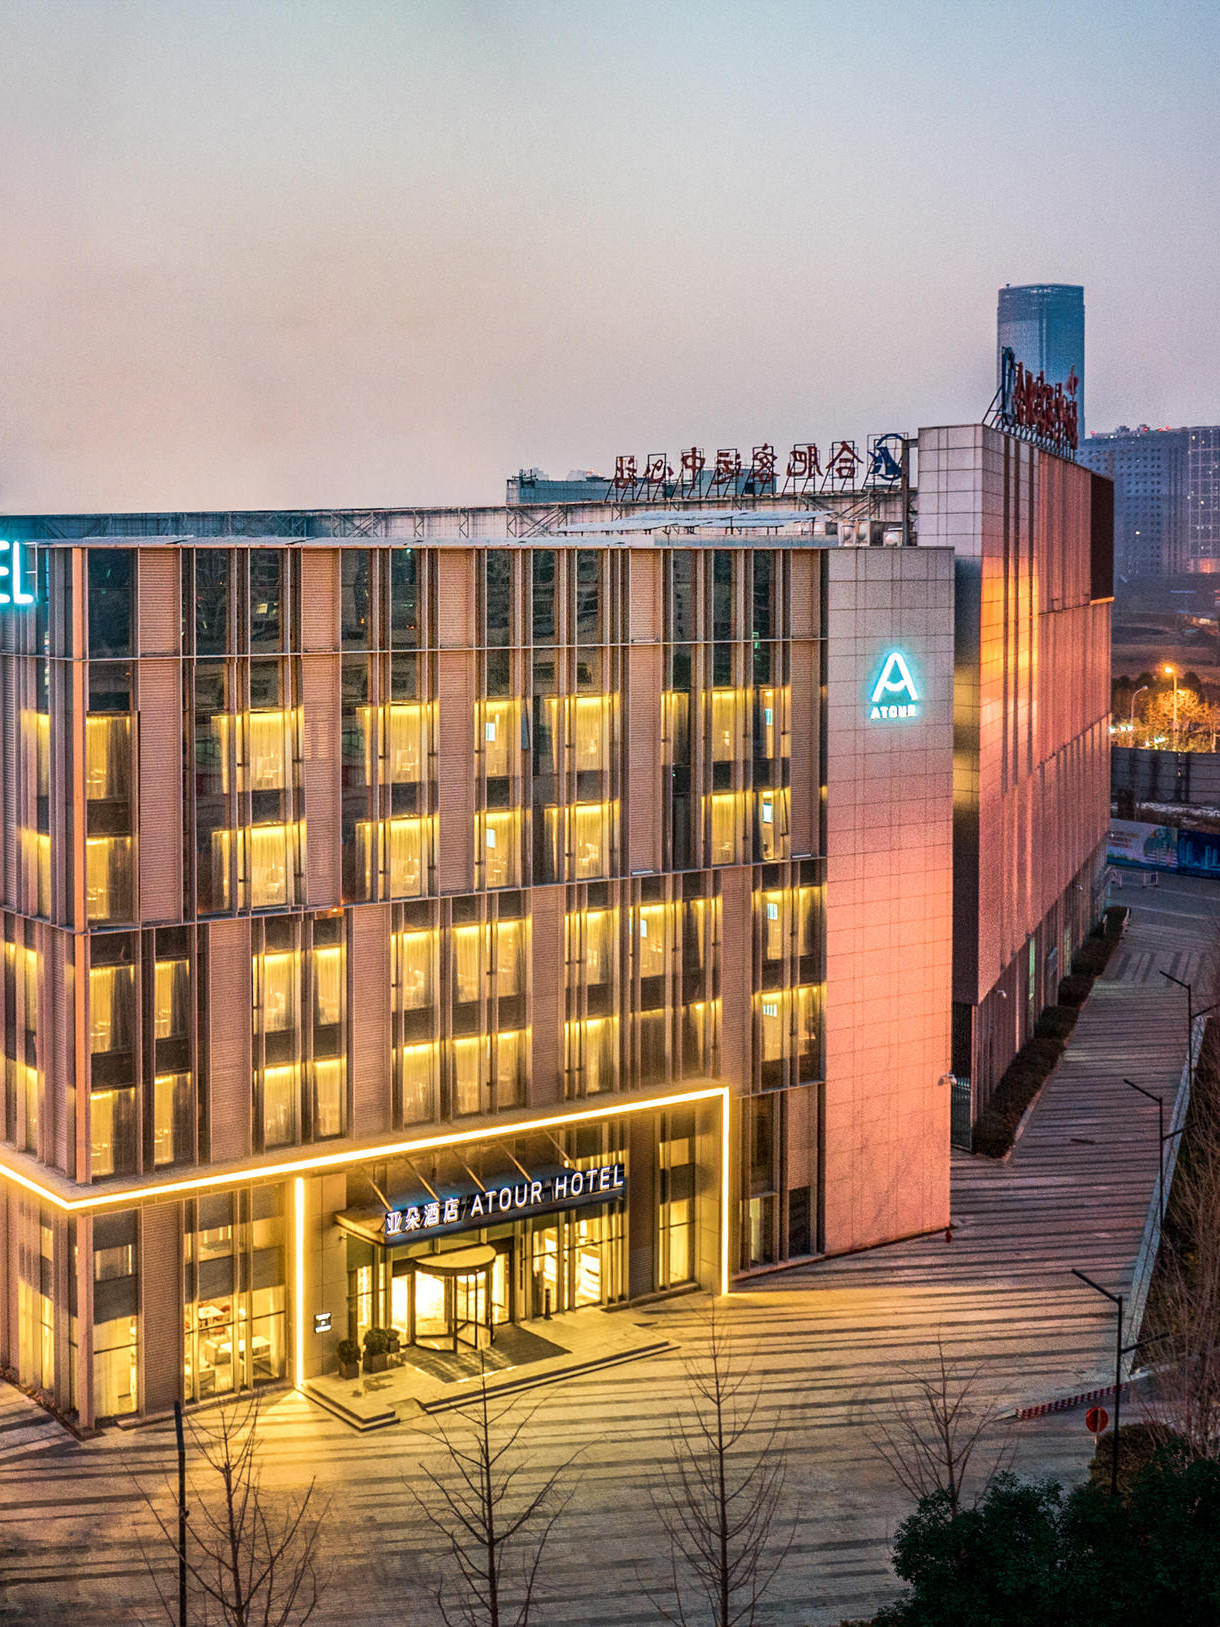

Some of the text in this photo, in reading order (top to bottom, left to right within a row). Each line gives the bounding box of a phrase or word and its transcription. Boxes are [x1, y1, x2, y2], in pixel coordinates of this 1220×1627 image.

[470, 1163, 624, 1218] ATOUR HOTEL
[386, 1197, 460, 1236] 亚朵酒店
